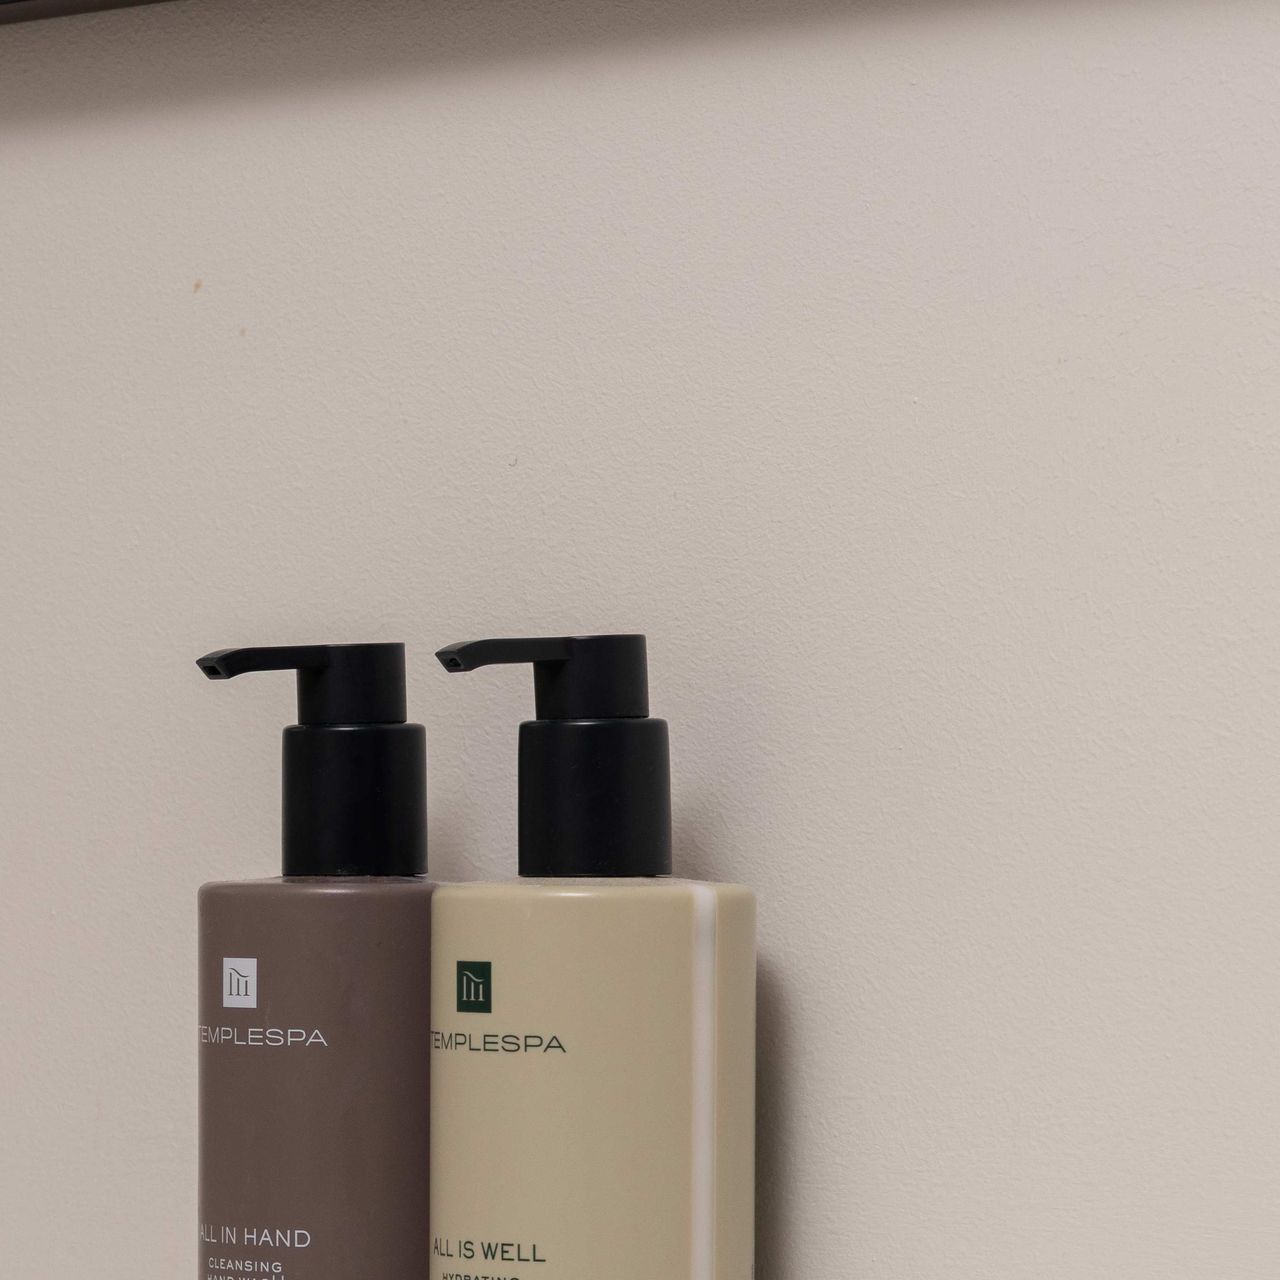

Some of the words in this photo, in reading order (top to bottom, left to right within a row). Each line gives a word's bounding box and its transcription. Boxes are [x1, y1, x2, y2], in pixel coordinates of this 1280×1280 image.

[200, 1224, 217, 1242] ALL
[221, 1225, 236, 1244] IN
[244, 1228, 311, 1248] HAND
[434, 1237, 453, 1257] ALL
[459, 1240, 475, 1259] IS
[481, 1242, 546, 1262] WELL
[208, 1257, 282, 1273] CLEANSING
